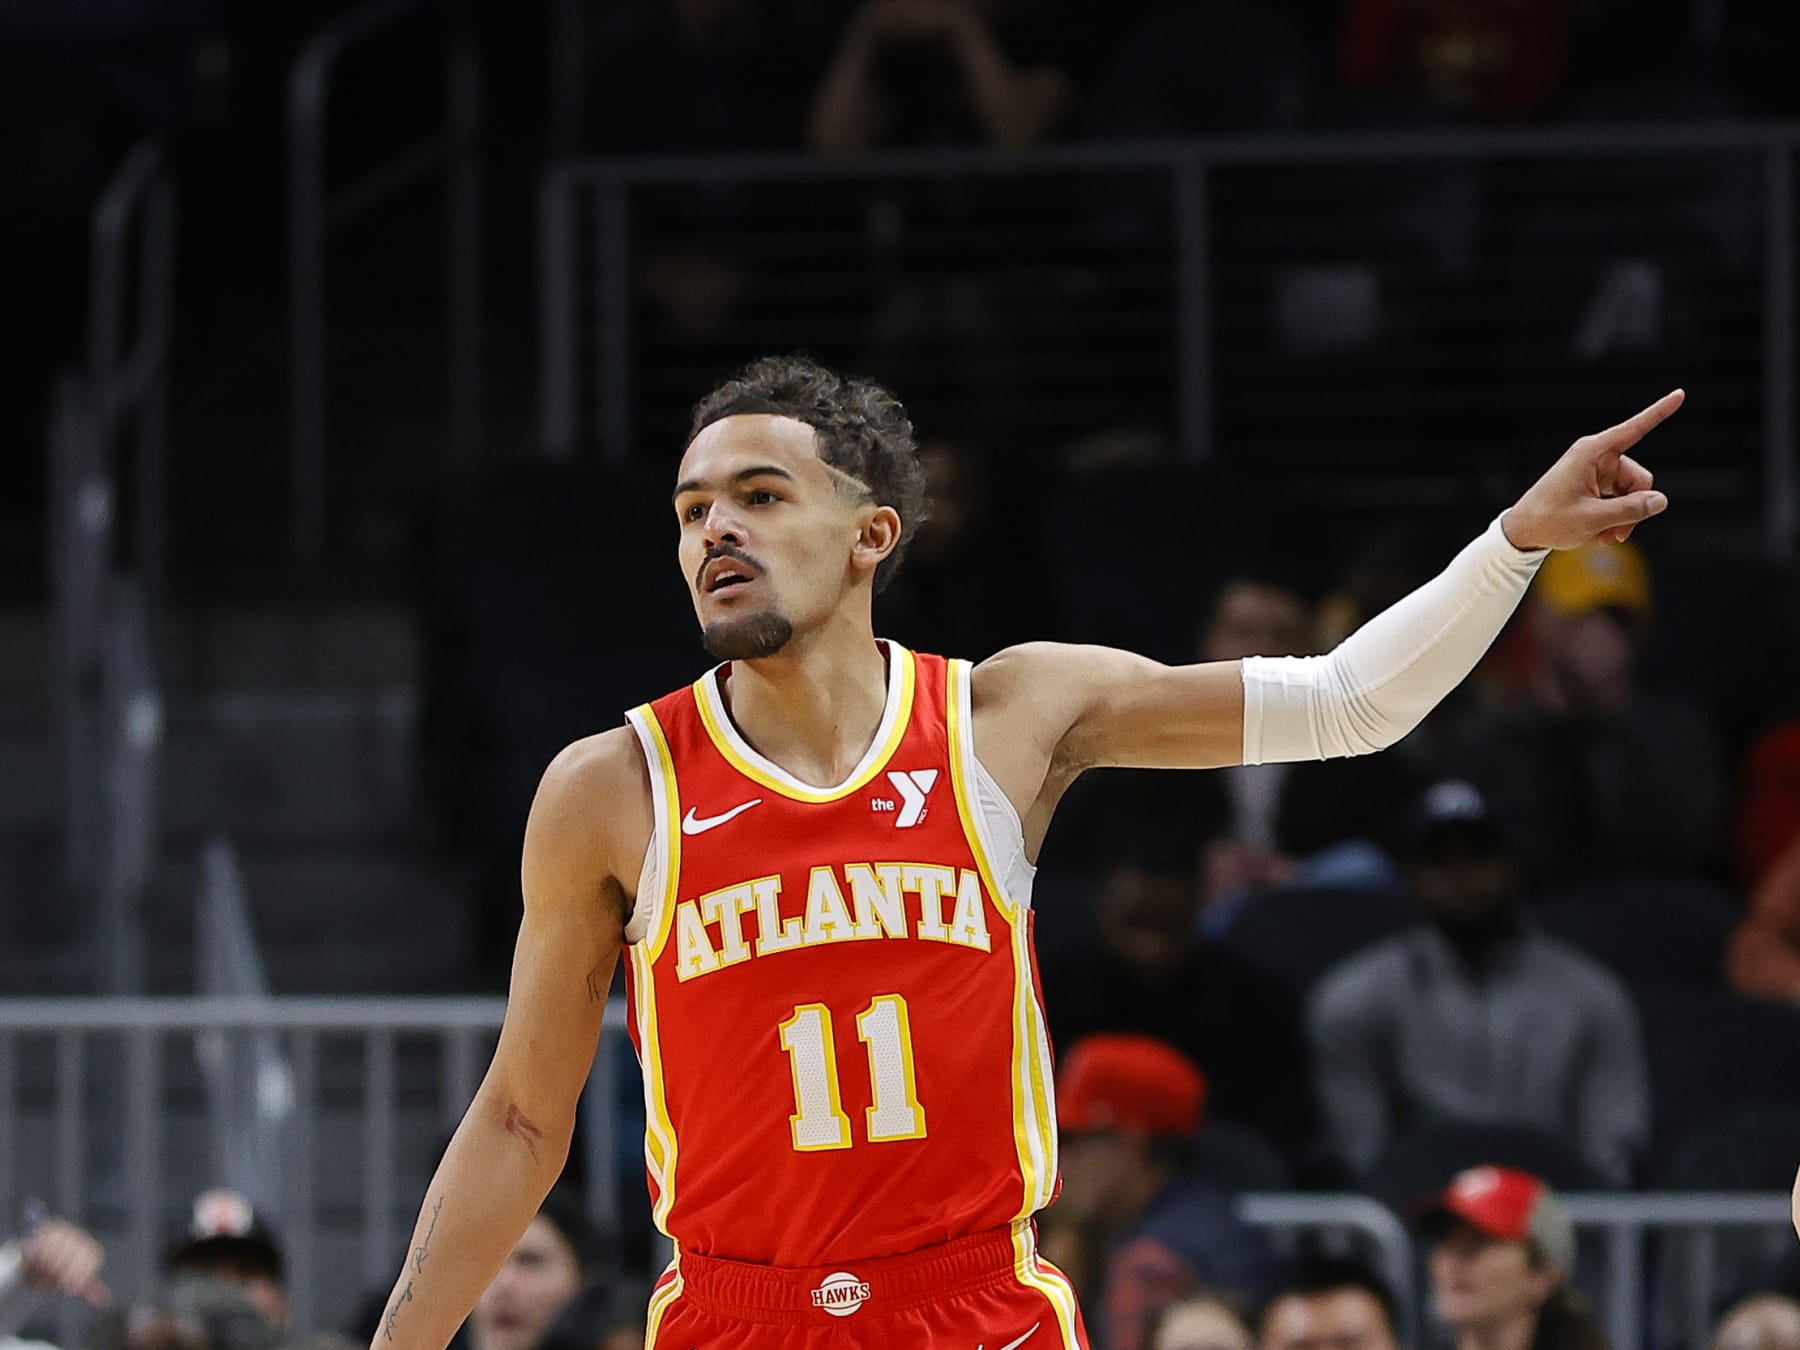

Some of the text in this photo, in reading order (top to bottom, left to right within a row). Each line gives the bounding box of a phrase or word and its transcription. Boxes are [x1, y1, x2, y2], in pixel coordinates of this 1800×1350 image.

[871, 769, 938, 828] the Y
[675, 862, 991, 983] ATLANTA
[778, 994, 927, 1152] 11
[812, 1284, 870, 1305] HAWKS
